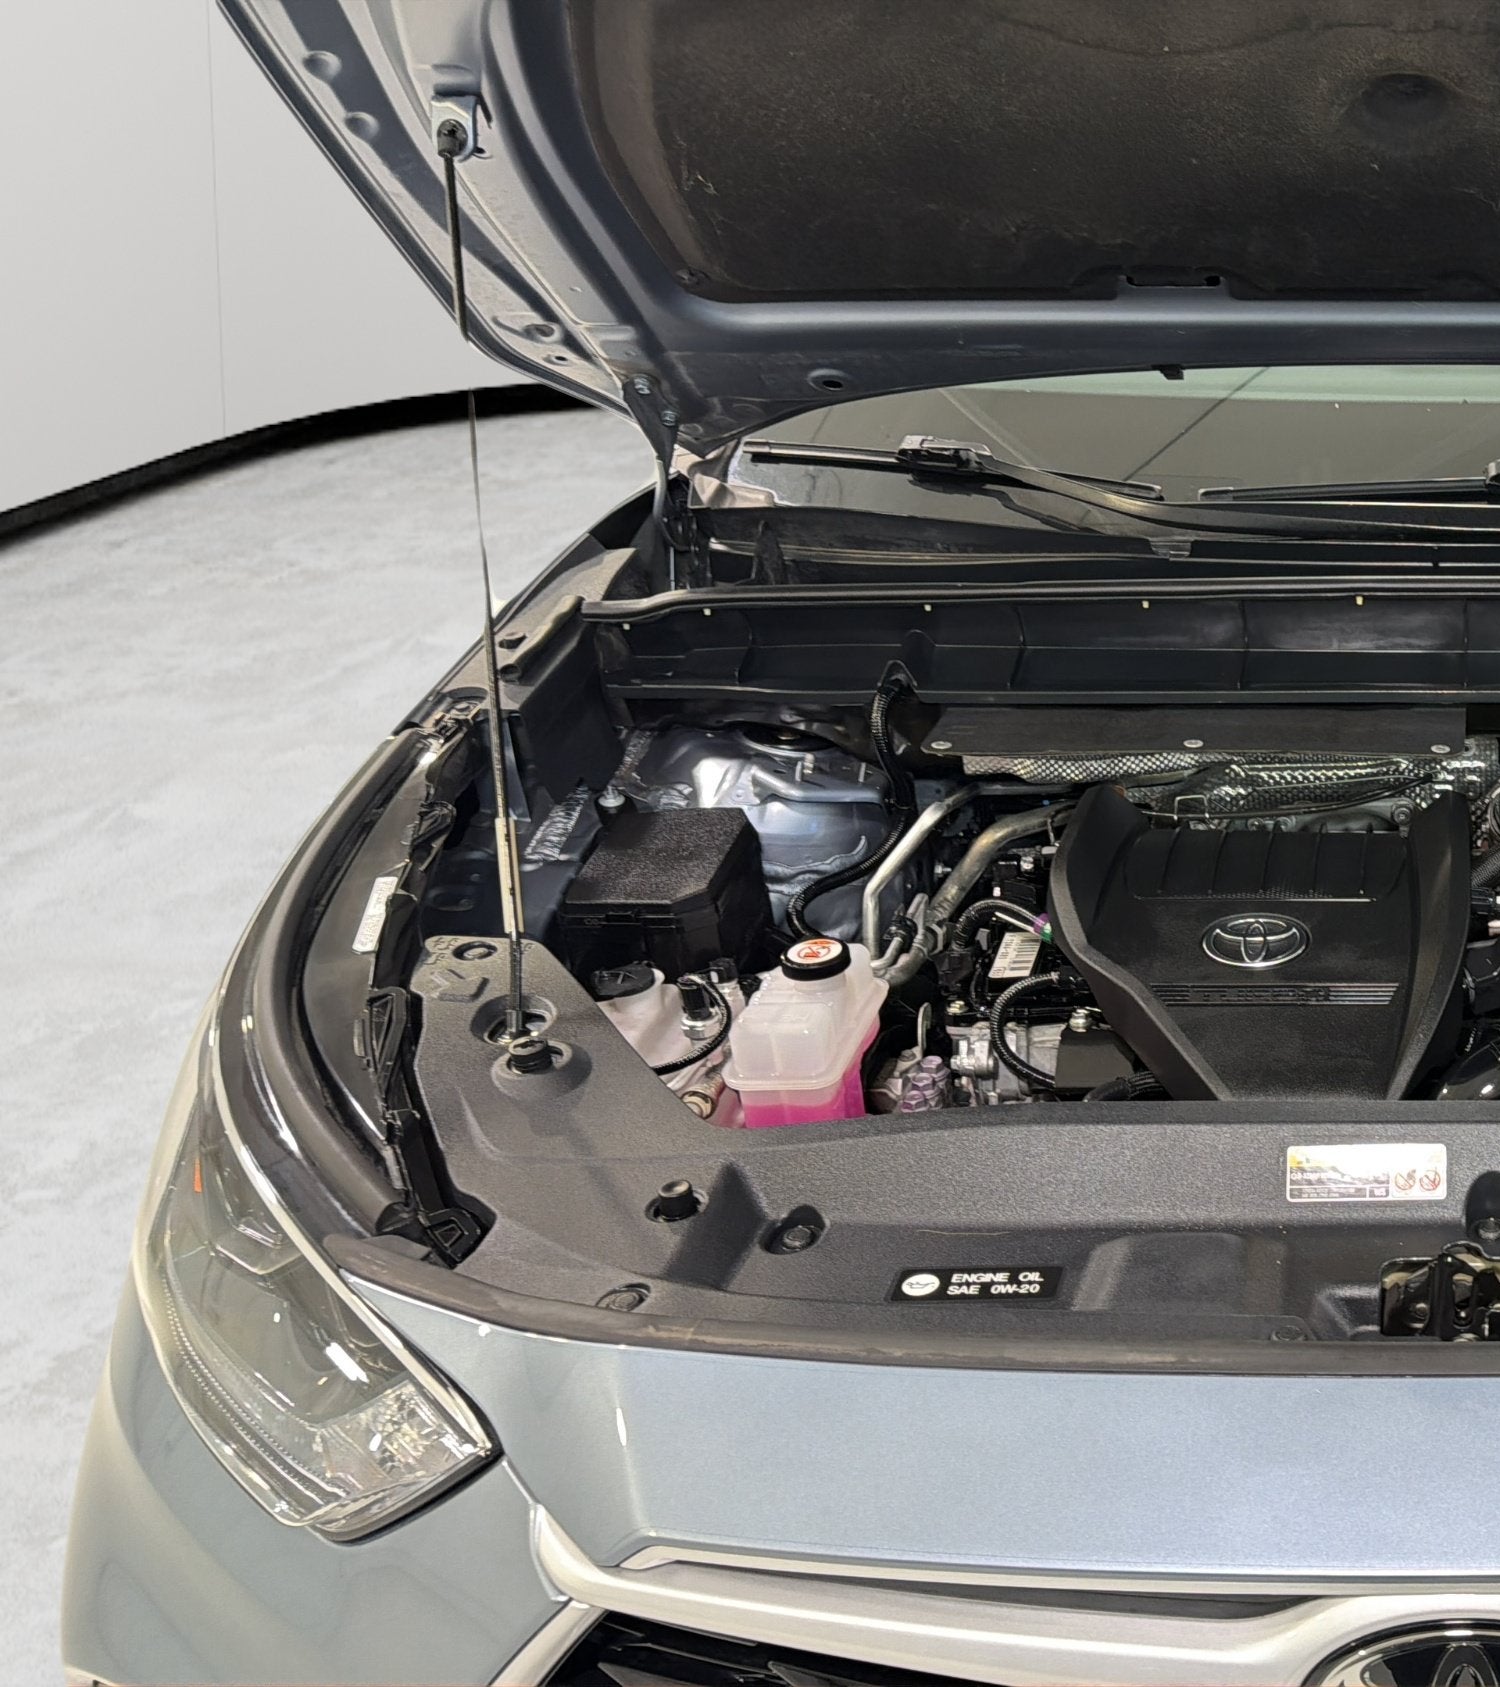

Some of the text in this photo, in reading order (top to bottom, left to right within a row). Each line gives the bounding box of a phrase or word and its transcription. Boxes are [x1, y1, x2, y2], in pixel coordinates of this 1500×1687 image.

[951, 1272, 1044, 1283] ENGINE OIL
[946, 1284, 1041, 1295] SAE 0W-20
